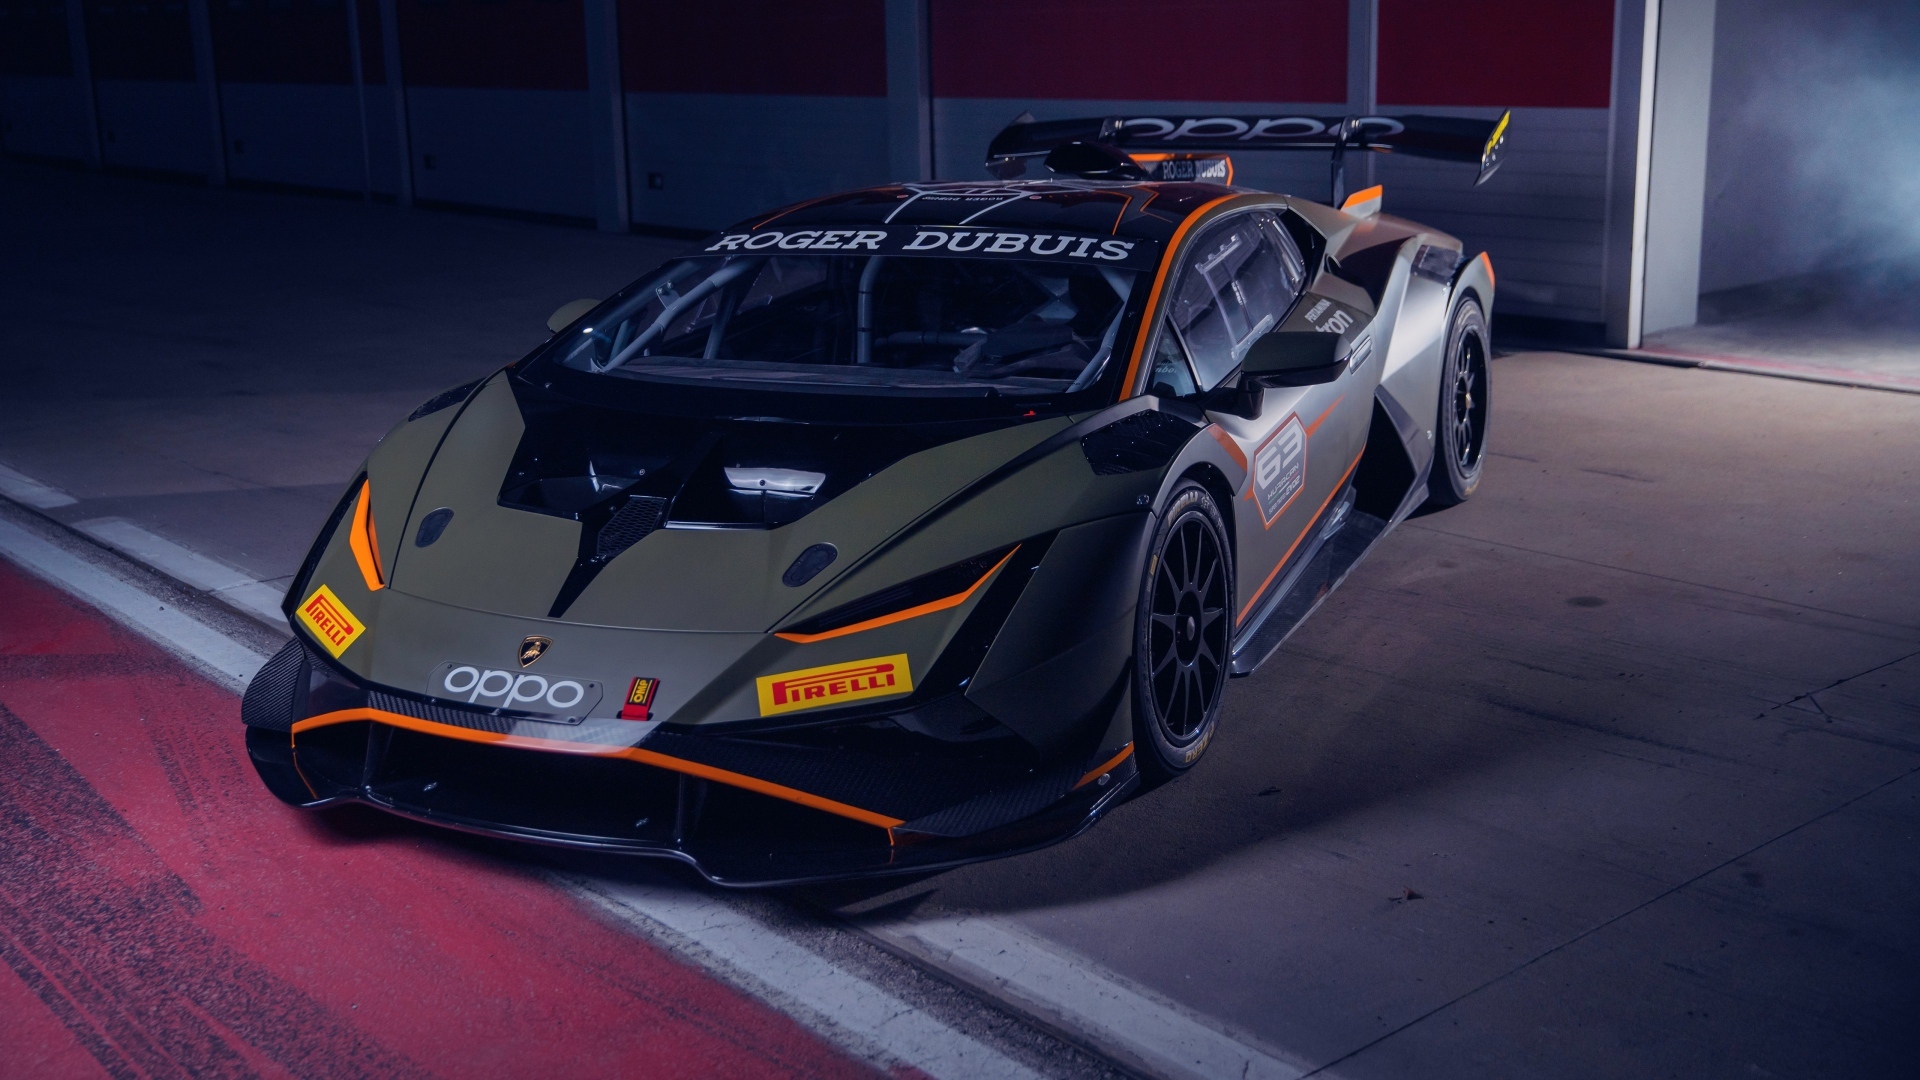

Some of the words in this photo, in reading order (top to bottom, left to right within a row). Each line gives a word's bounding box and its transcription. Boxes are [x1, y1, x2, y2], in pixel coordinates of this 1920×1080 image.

[1162, 161, 1195, 180] ROGER
[1194, 160, 1226, 178] DUBUIS
[705, 230, 888, 252] ROGER
[902, 231, 1134, 260] DUBUIS
[1315, 309, 1354, 334] tron
[1257, 423, 1302, 489] 63
[305, 593, 354, 647] PIRELLI
[445, 667, 585, 709] oppo
[633, 679, 648, 703] OMP
[771, 663, 896, 706] PIRELLI
